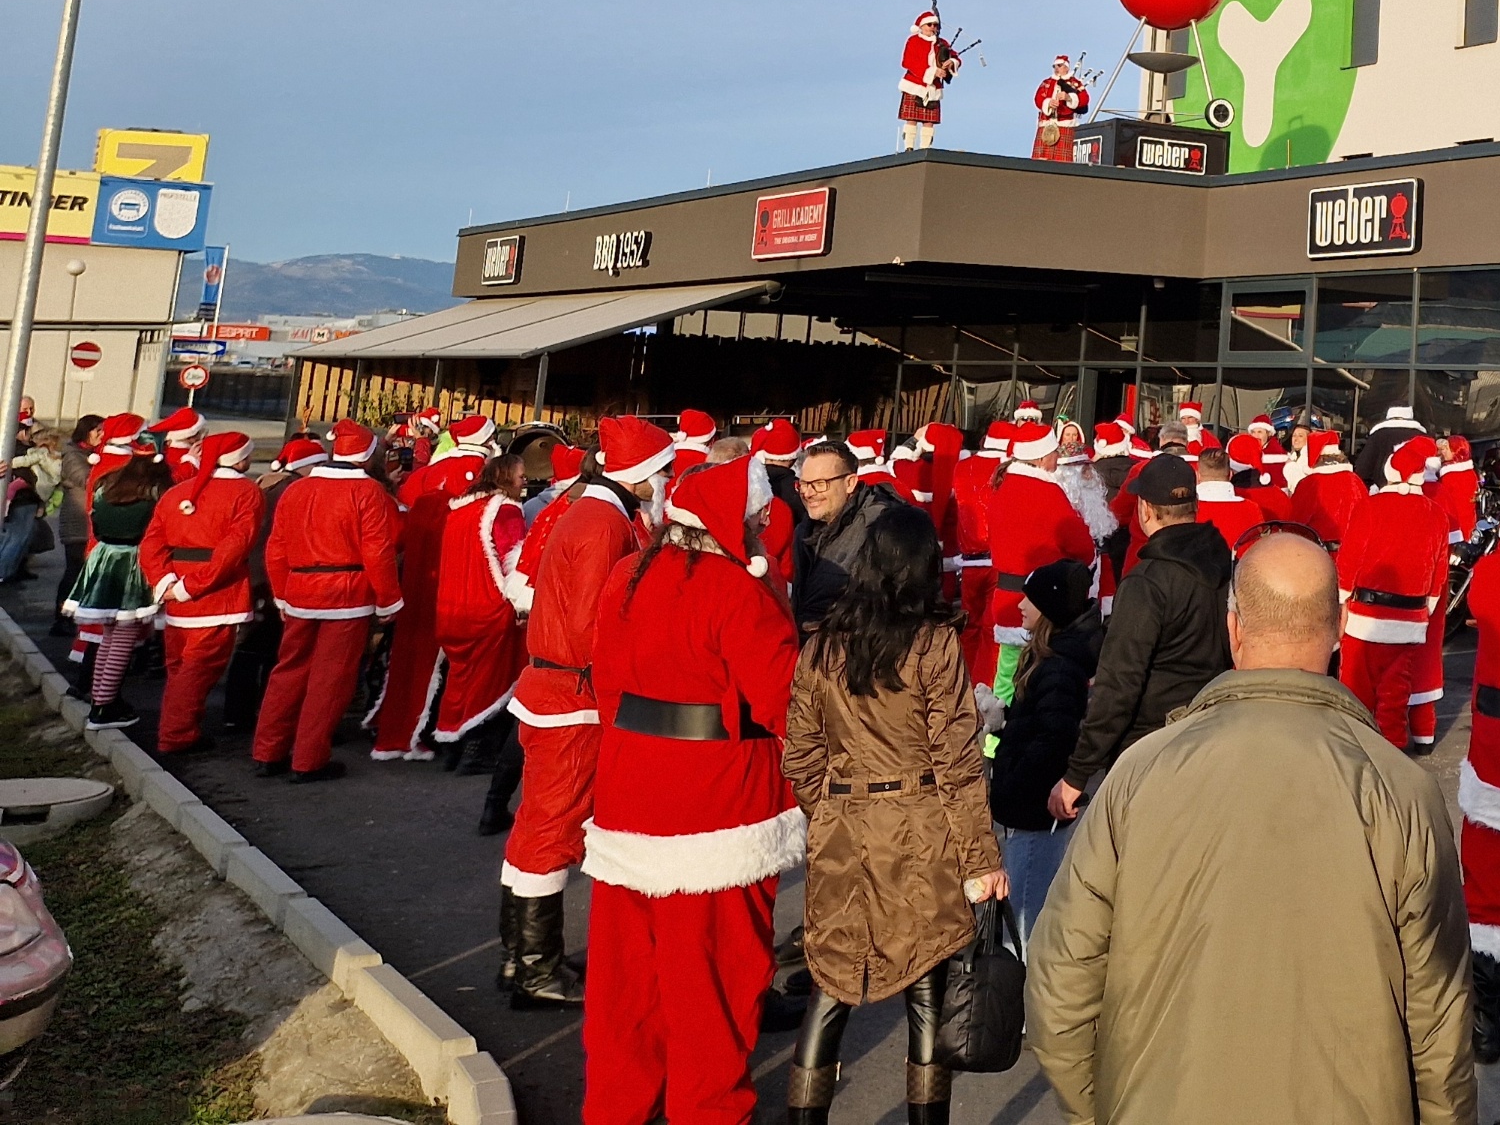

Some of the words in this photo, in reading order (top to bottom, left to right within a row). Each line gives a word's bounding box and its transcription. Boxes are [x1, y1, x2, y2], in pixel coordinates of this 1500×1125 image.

[1073, 140, 1092, 164] eber
[1142, 141, 1190, 169] weber
[772, 208, 791, 229] GRILL
[790, 204, 824, 226] ACADEMY
[1315, 187, 1388, 248] weber
[485, 242, 510, 278] weber
[593, 233, 617, 276] BBQ
[617, 230, 646, 269] 1952
[219, 327, 259, 338] ESPRIT
